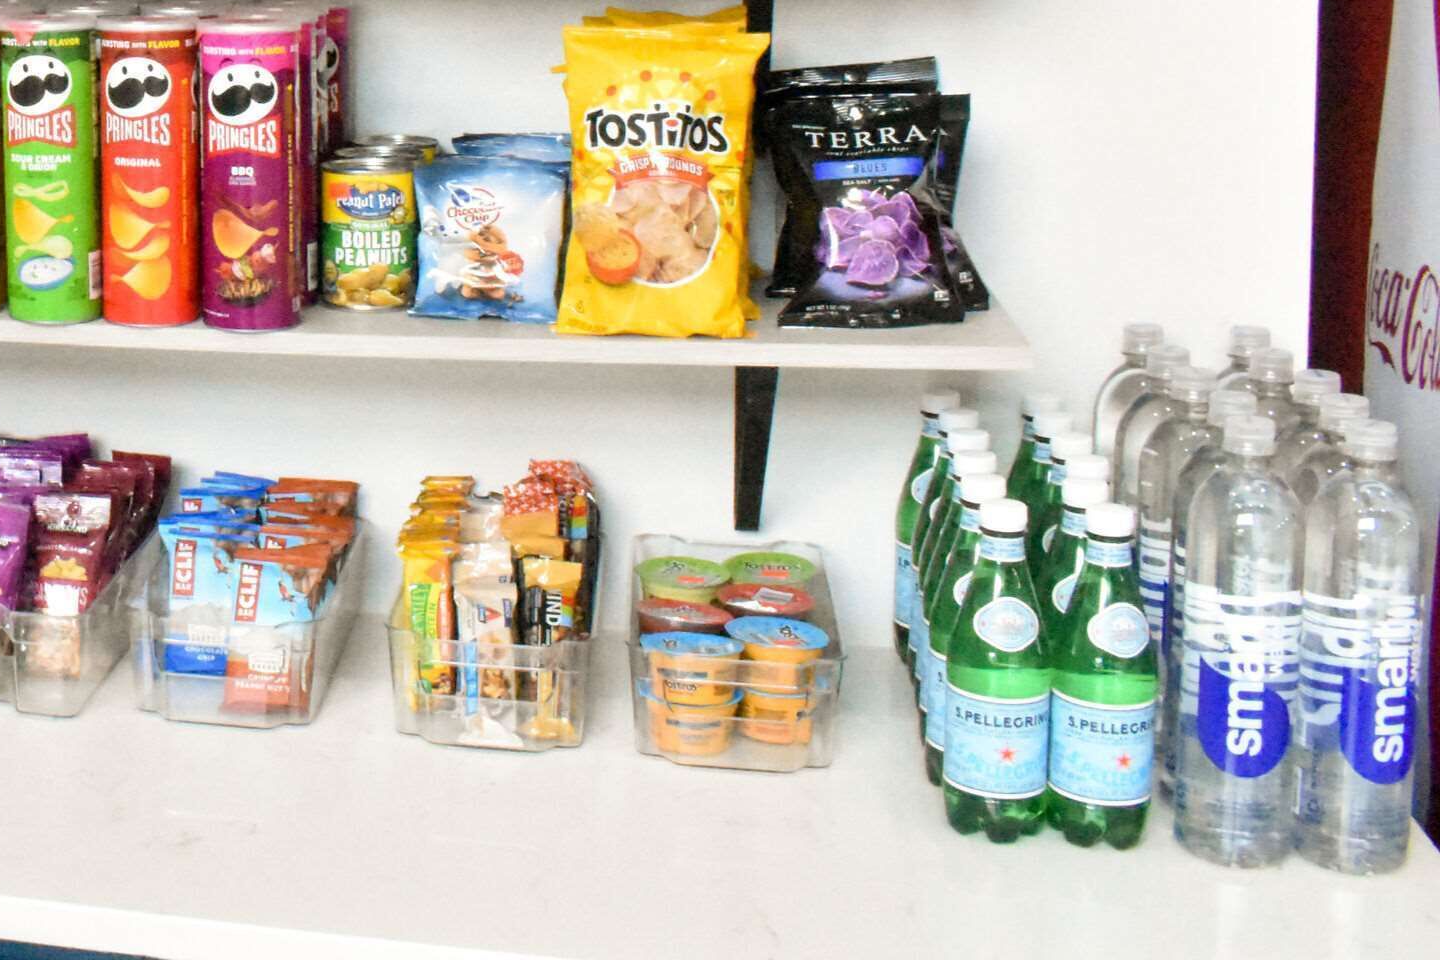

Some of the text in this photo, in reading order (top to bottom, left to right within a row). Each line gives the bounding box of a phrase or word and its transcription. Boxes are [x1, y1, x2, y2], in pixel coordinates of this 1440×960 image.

[49, 38, 80, 47] FLAVOR
[148, 39, 180, 49] FLAVOR
[8, 109, 73, 144] PRINGLES
[106, 112, 170, 146] PRINGLES
[208, 120, 277, 153] PRINGLES
[805, 124, 928, 148] TERRA
[35, 153, 72, 163] CREAM
[114, 156, 161, 167] ORIGINAL
[620, 157, 703, 176] CRISP OUNDS
[853, 162, 888, 173] BLUES
[231, 166, 255, 178] BBQ
[342, 230, 401, 248] BOILED
[335, 247, 407, 267] PEANUTS
[176, 540, 195, 581] CLIF
[239, 563, 260, 608] CLIF
[546, 592, 561, 626] IND
[956, 706, 1049, 729] S.PELLEGRIN
[1068, 715, 1155, 735] S.PELLEGRI
